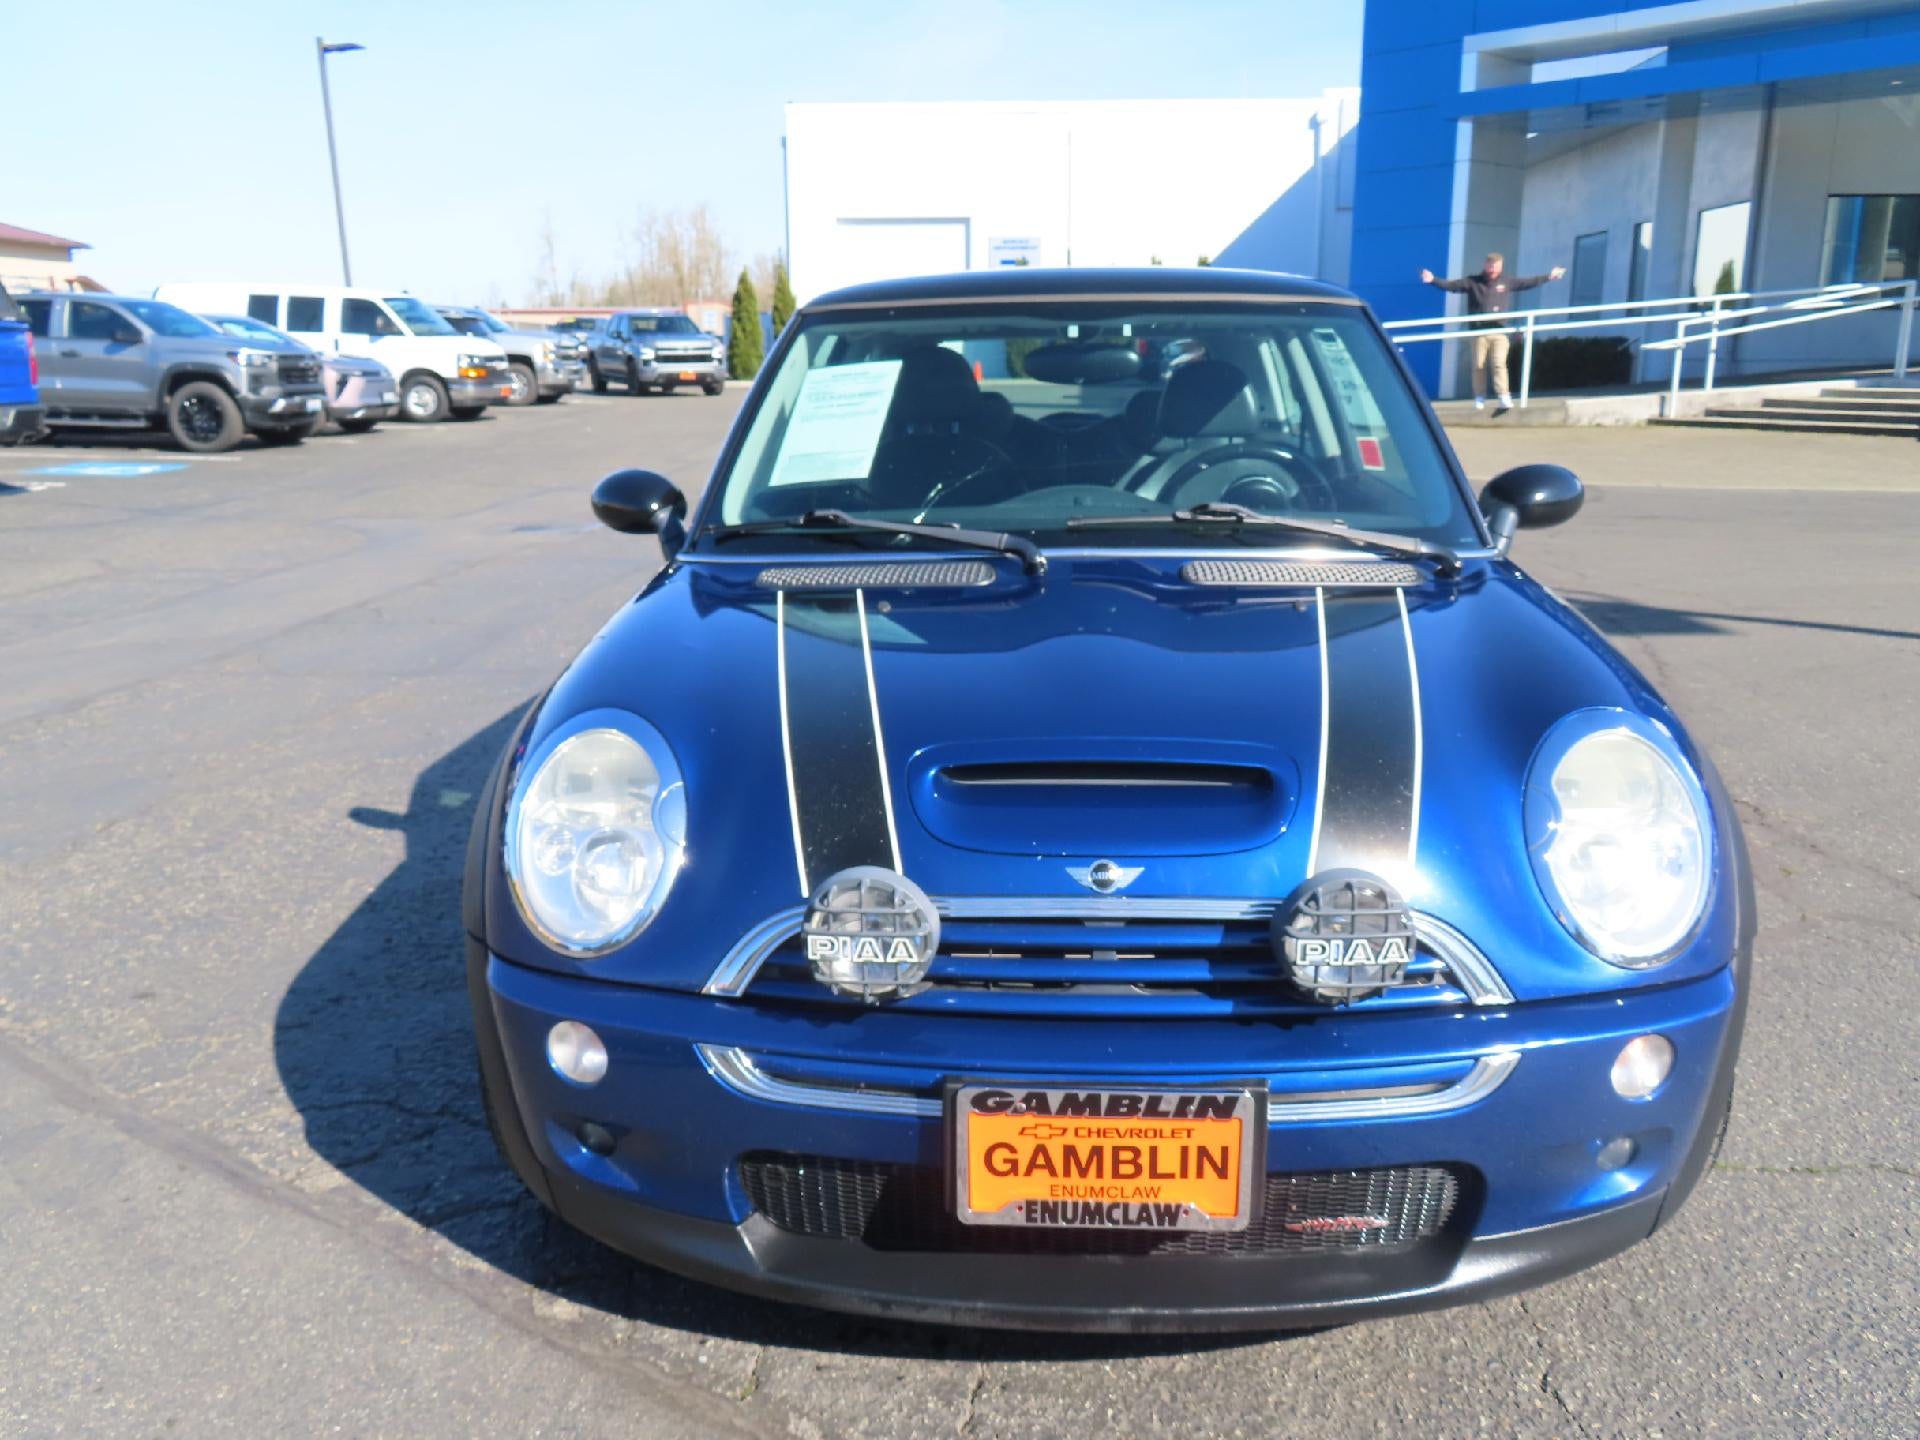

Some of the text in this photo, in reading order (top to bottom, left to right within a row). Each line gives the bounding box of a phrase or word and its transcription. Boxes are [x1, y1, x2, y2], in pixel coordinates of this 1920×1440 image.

[807, 935, 918, 963] PIAA
[1295, 938, 1410, 966] PIAA
[970, 1091, 1240, 1119] GAMBLIN
[1074, 1127, 1195, 1139] CHEVROLET
[983, 1142, 1229, 1180] GAMBLIN
[1050, 1184, 1161, 1199] ENUMCLAW
[1025, 1200, 1182, 1226] ENUMCLAW
